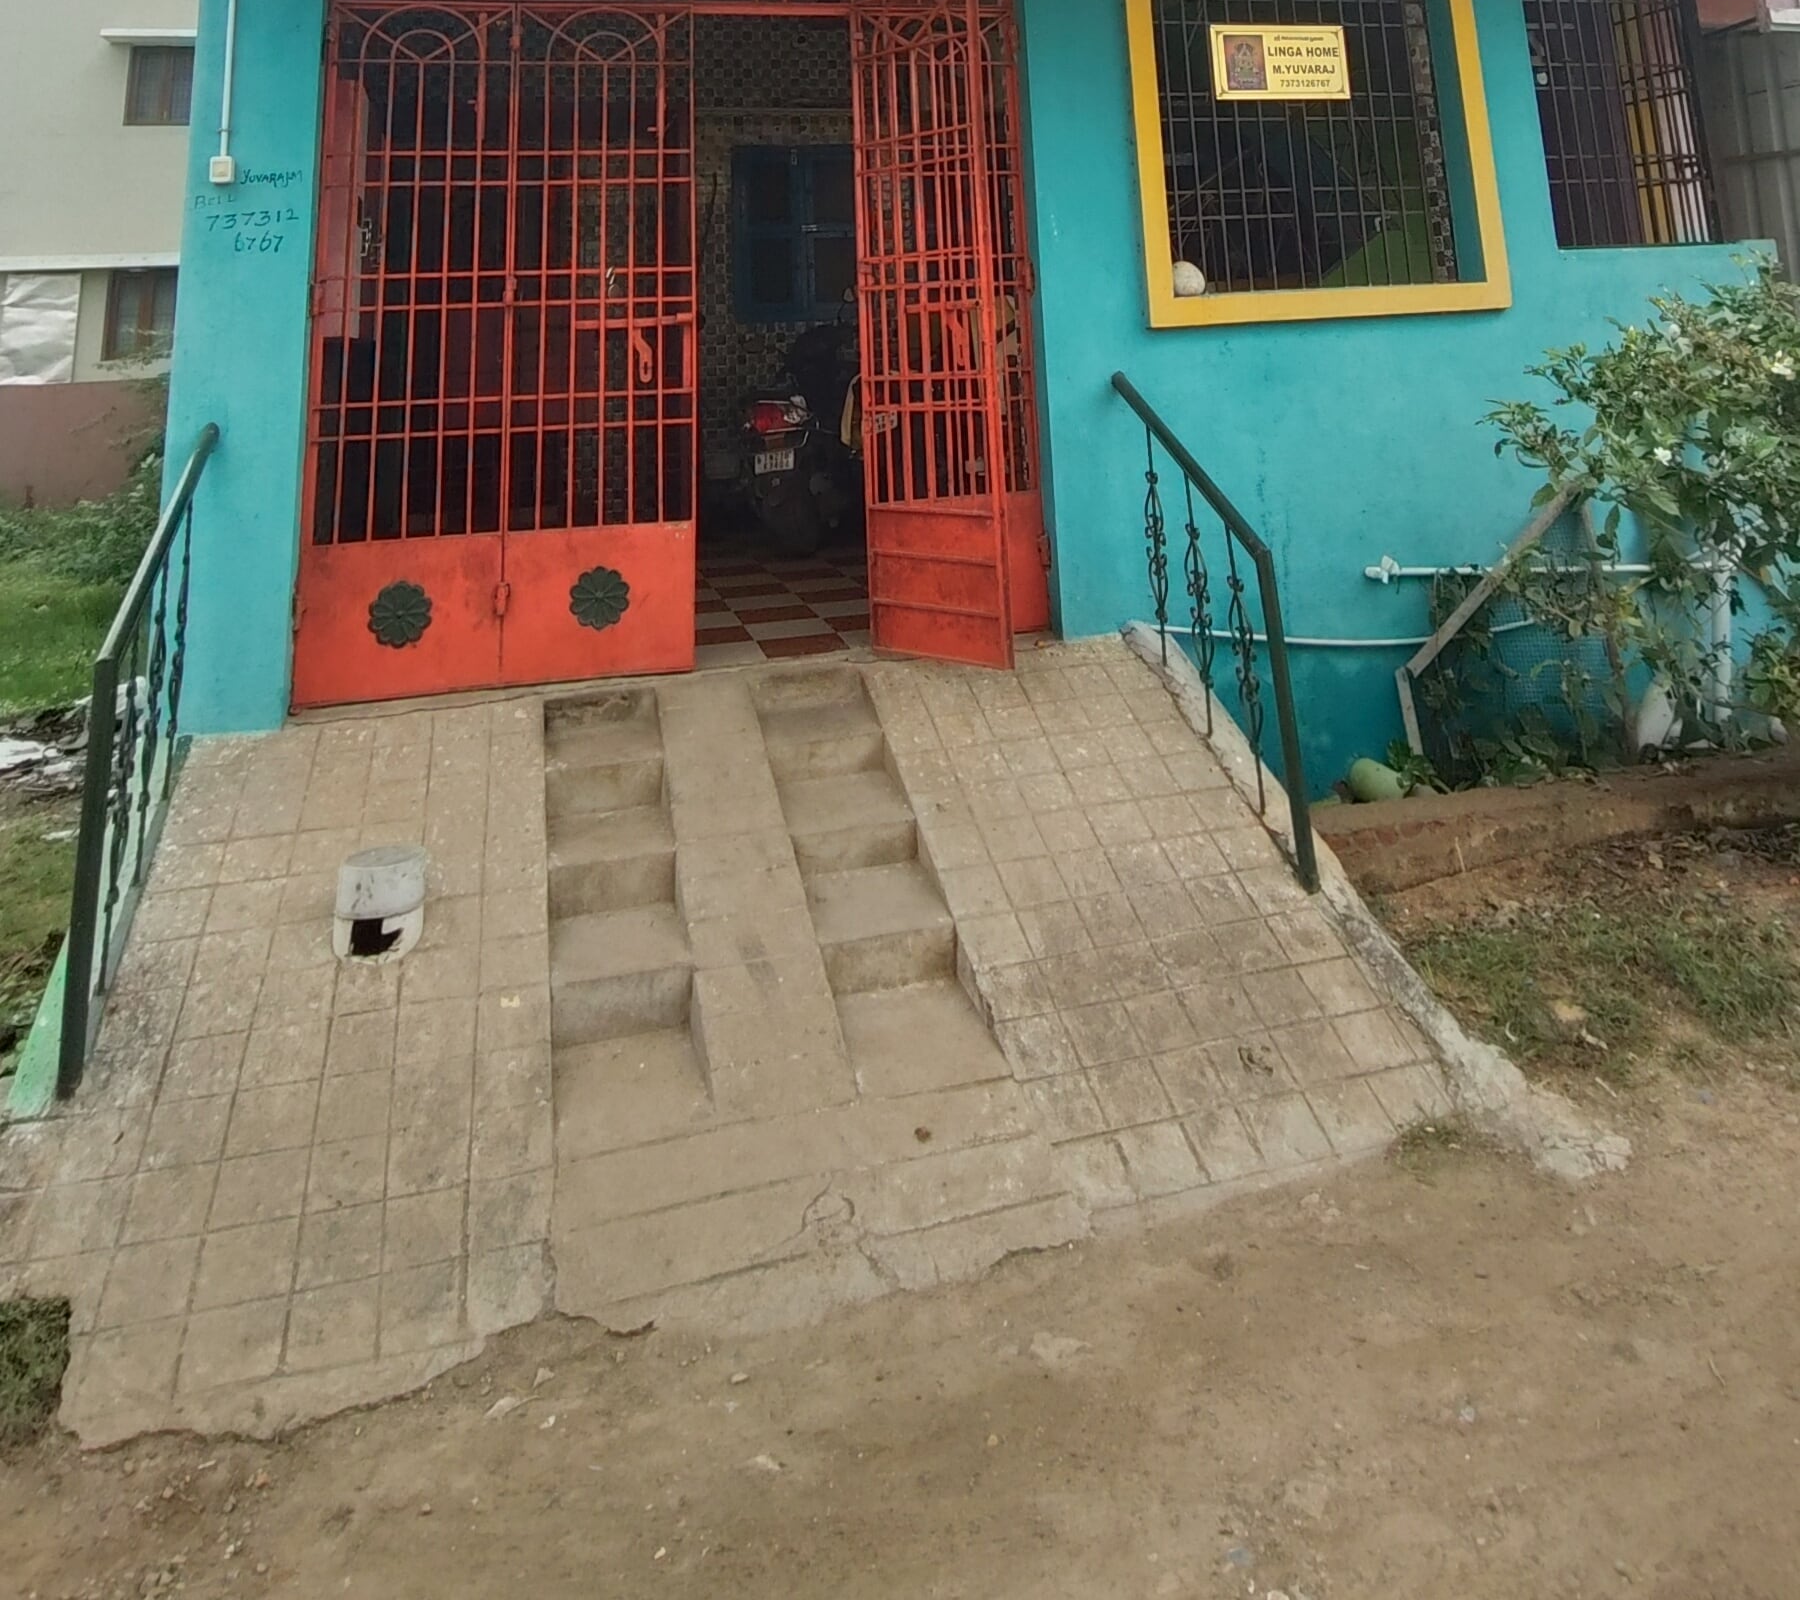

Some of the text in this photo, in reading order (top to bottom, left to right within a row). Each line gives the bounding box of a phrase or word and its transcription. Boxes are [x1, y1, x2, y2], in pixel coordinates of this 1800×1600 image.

[1267, 46, 1339, 58] LINGA HOME
[1272, 64, 1335, 75] M.YUVARAJ
[1280, 79, 1331, 88] 7373126767
[206, 208, 299, 231] 737312
[234, 230, 284, 253] 6767
